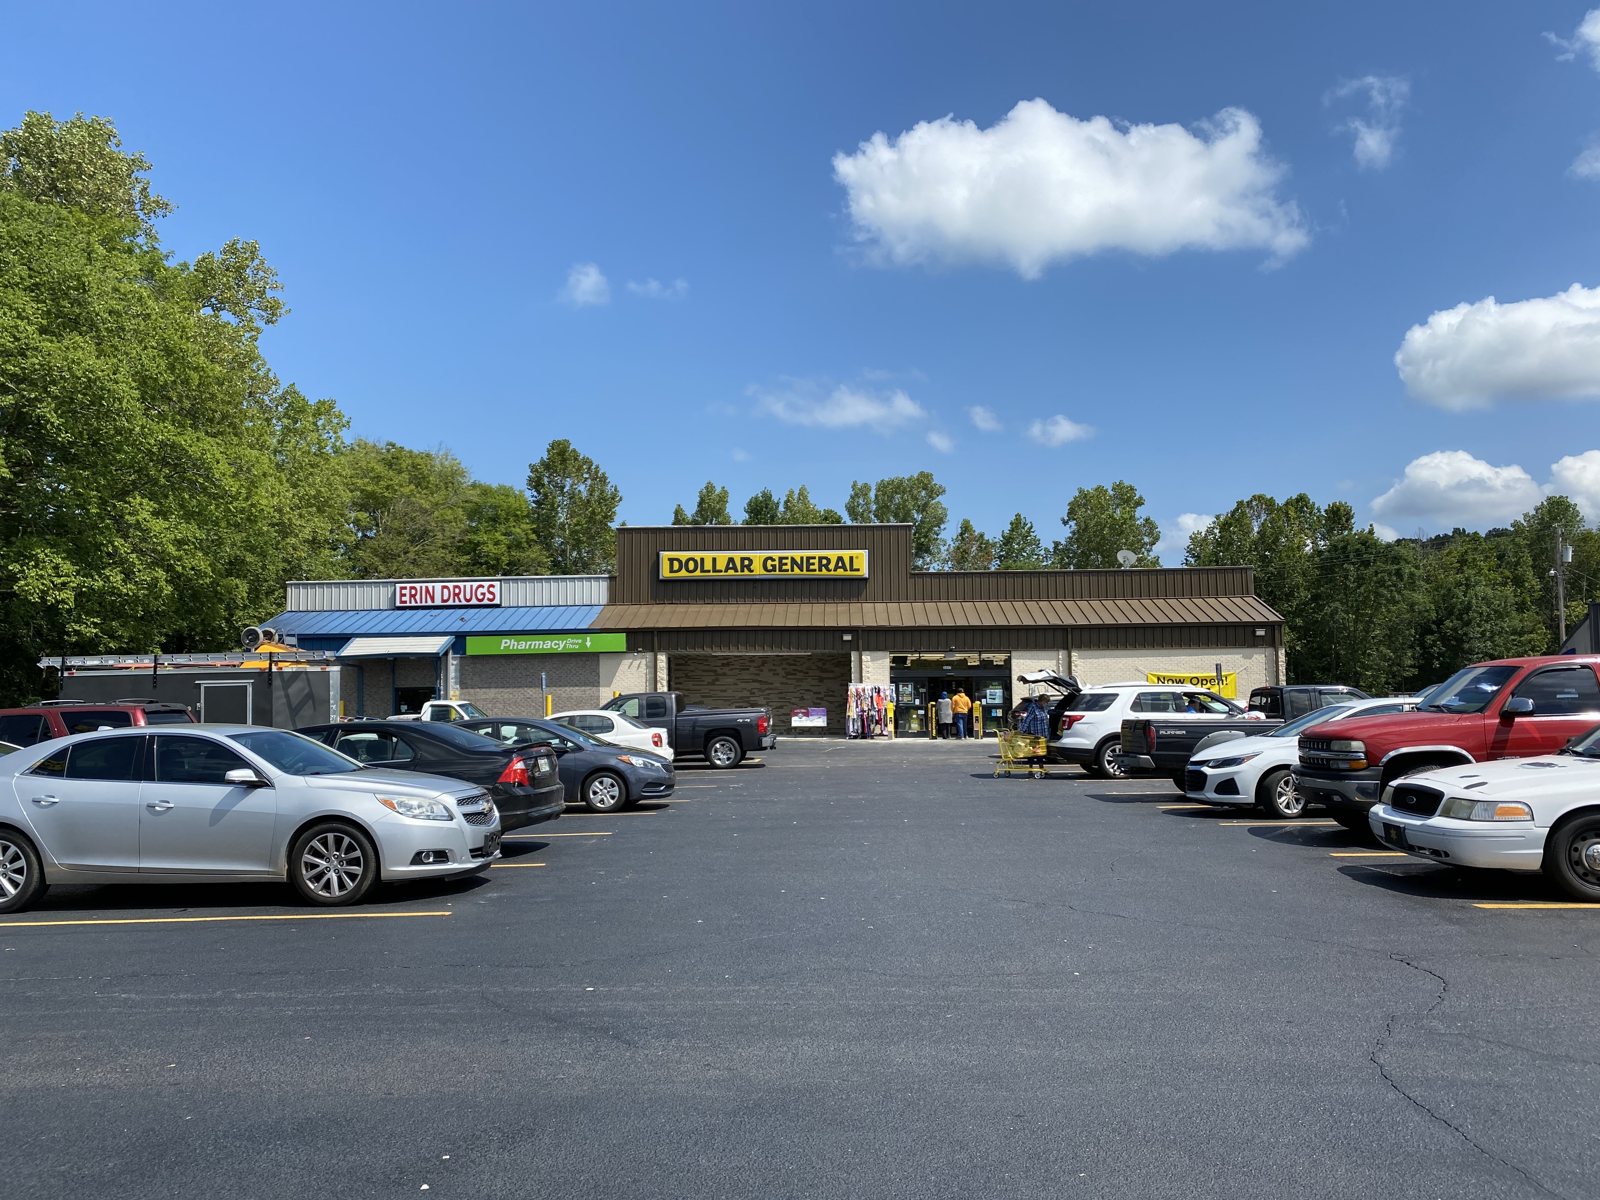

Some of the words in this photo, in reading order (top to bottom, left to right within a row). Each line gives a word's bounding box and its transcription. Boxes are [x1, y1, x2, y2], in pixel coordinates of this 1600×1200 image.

[667, 556, 754, 574] DOLLAR
[762, 555, 861, 573] GENERAL
[399, 585, 435, 605] ERIN
[440, 583, 496, 603] DRUGS
[500, 639, 566, 651] Pharmacy
[1156, 676, 1186, 685] Now
[1189, 676, 1229, 688] Open!
